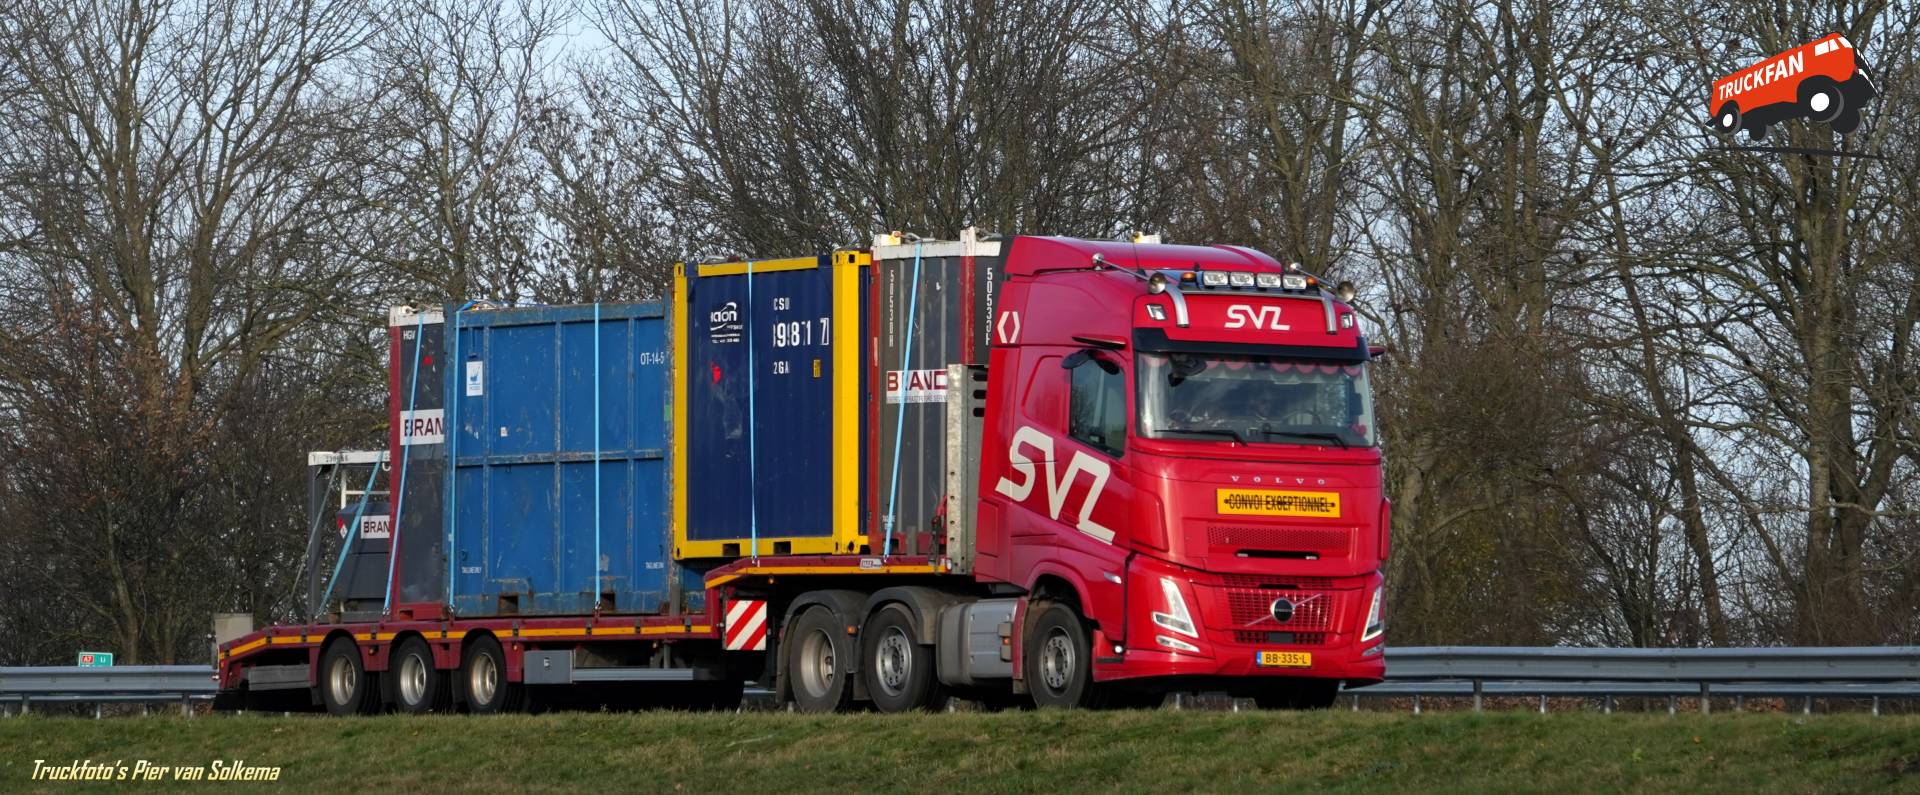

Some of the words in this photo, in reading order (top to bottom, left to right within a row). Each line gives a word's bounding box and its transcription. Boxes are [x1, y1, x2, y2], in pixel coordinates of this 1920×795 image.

[1231, 474, 1326, 486] VOLVO
[1229, 494, 1263, 511] CONVOI
[1265, 653, 1308, 664] BB-335-L
